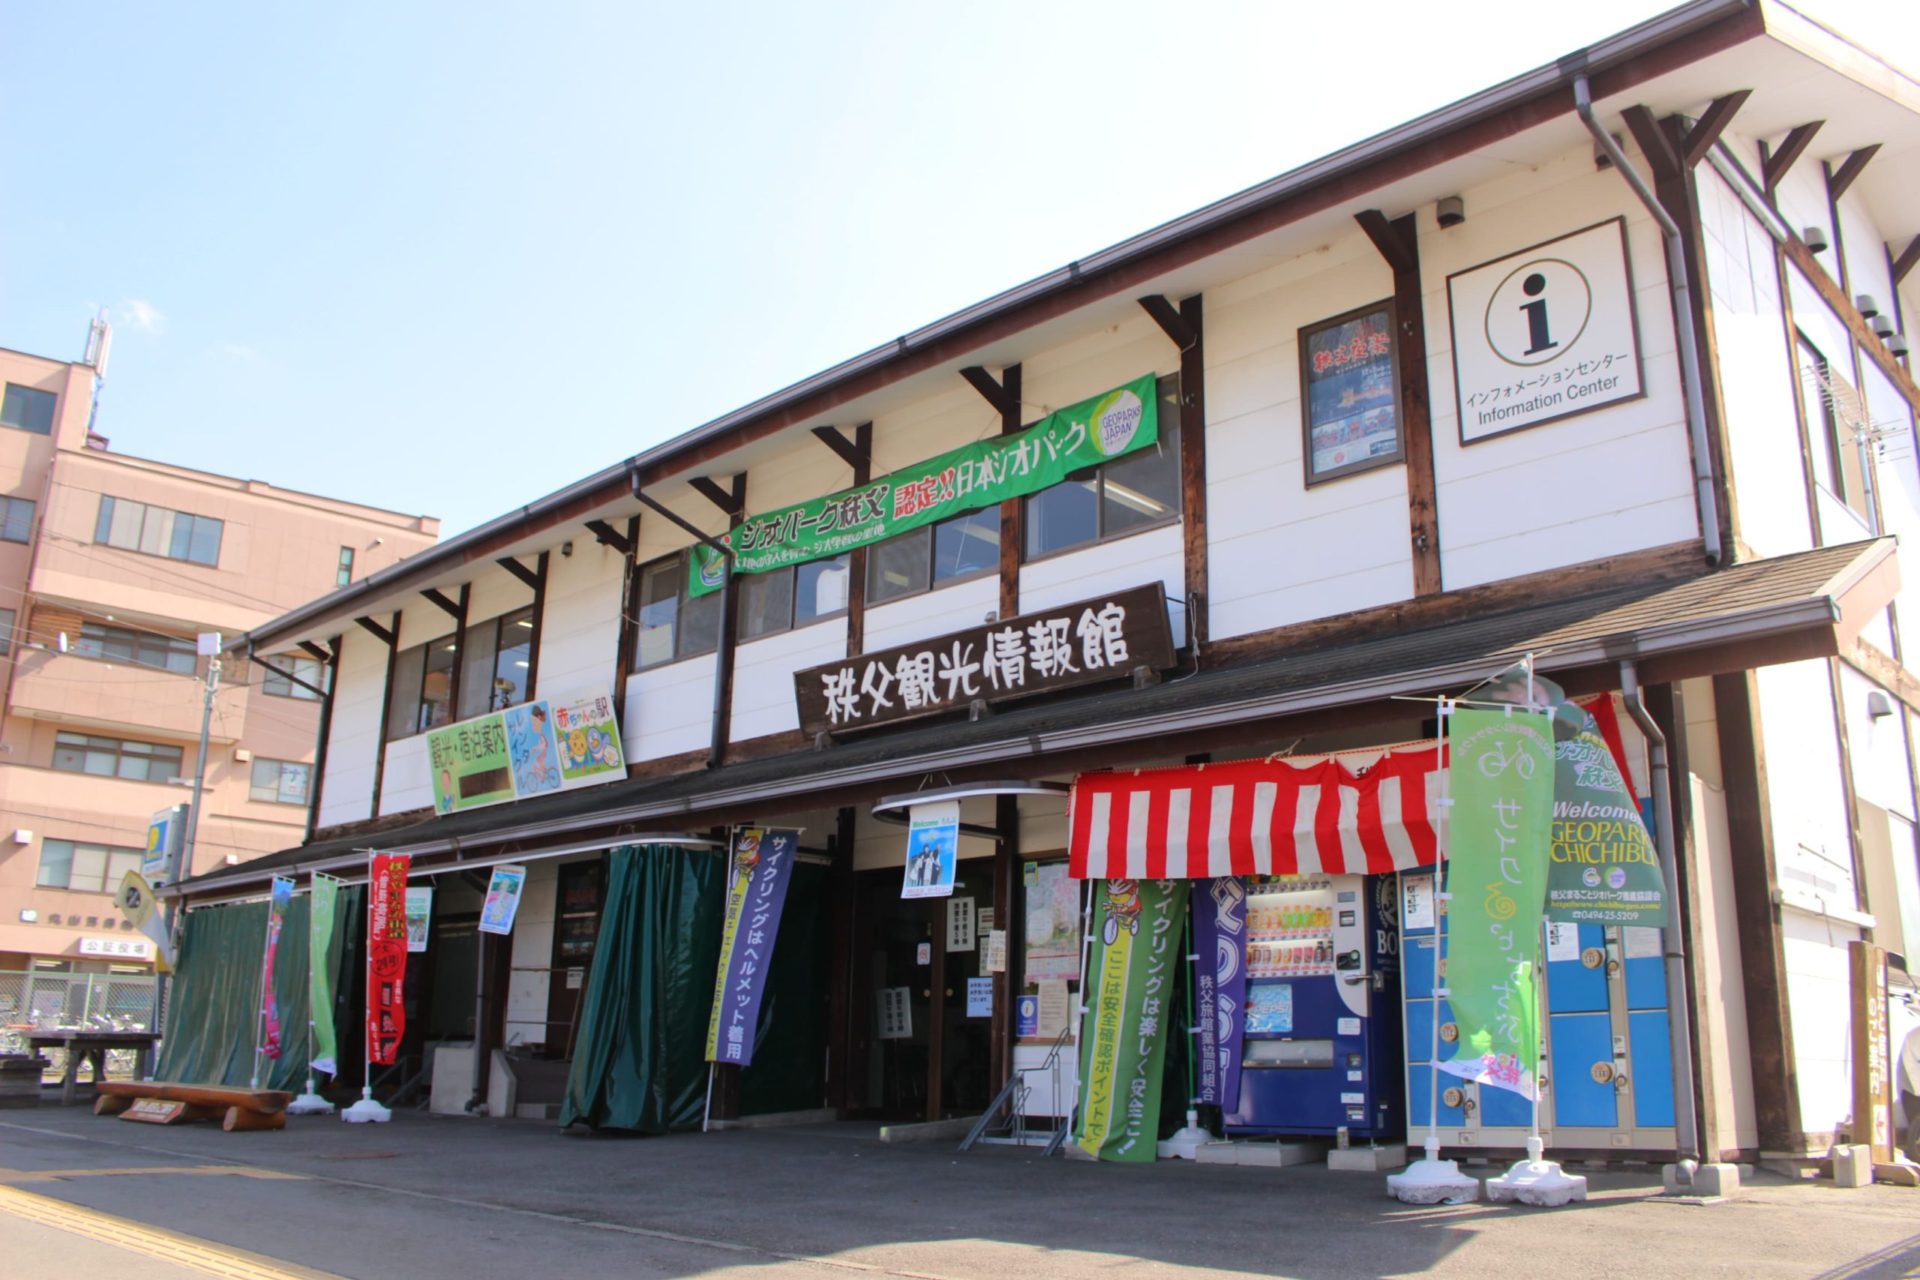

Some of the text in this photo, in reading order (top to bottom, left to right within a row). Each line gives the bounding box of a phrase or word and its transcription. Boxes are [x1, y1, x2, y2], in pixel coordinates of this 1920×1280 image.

[1466, 353, 1628, 408] インフォメーションセンター
[1478, 374, 1619, 425] Information Center
[1102, 405, 1141, 428] GEOPARKS
[1104, 421, 1132, 441] JAPAN
[741, 484, 888, 552] ジオパーク秩父
[956, 421, 1087, 494] 日本ジオパーク
[822, 602, 1129, 725] 秩父観光情報館
[556, 696, 610, 728] 赤ちゃんの駅
[1550, 842, 1655, 866] CHICHIBU
[726, 836, 788, 1060] サイクリングはヘルメット着用
[1200, 974, 1216, 1102] 秩父旅館業協同組合
